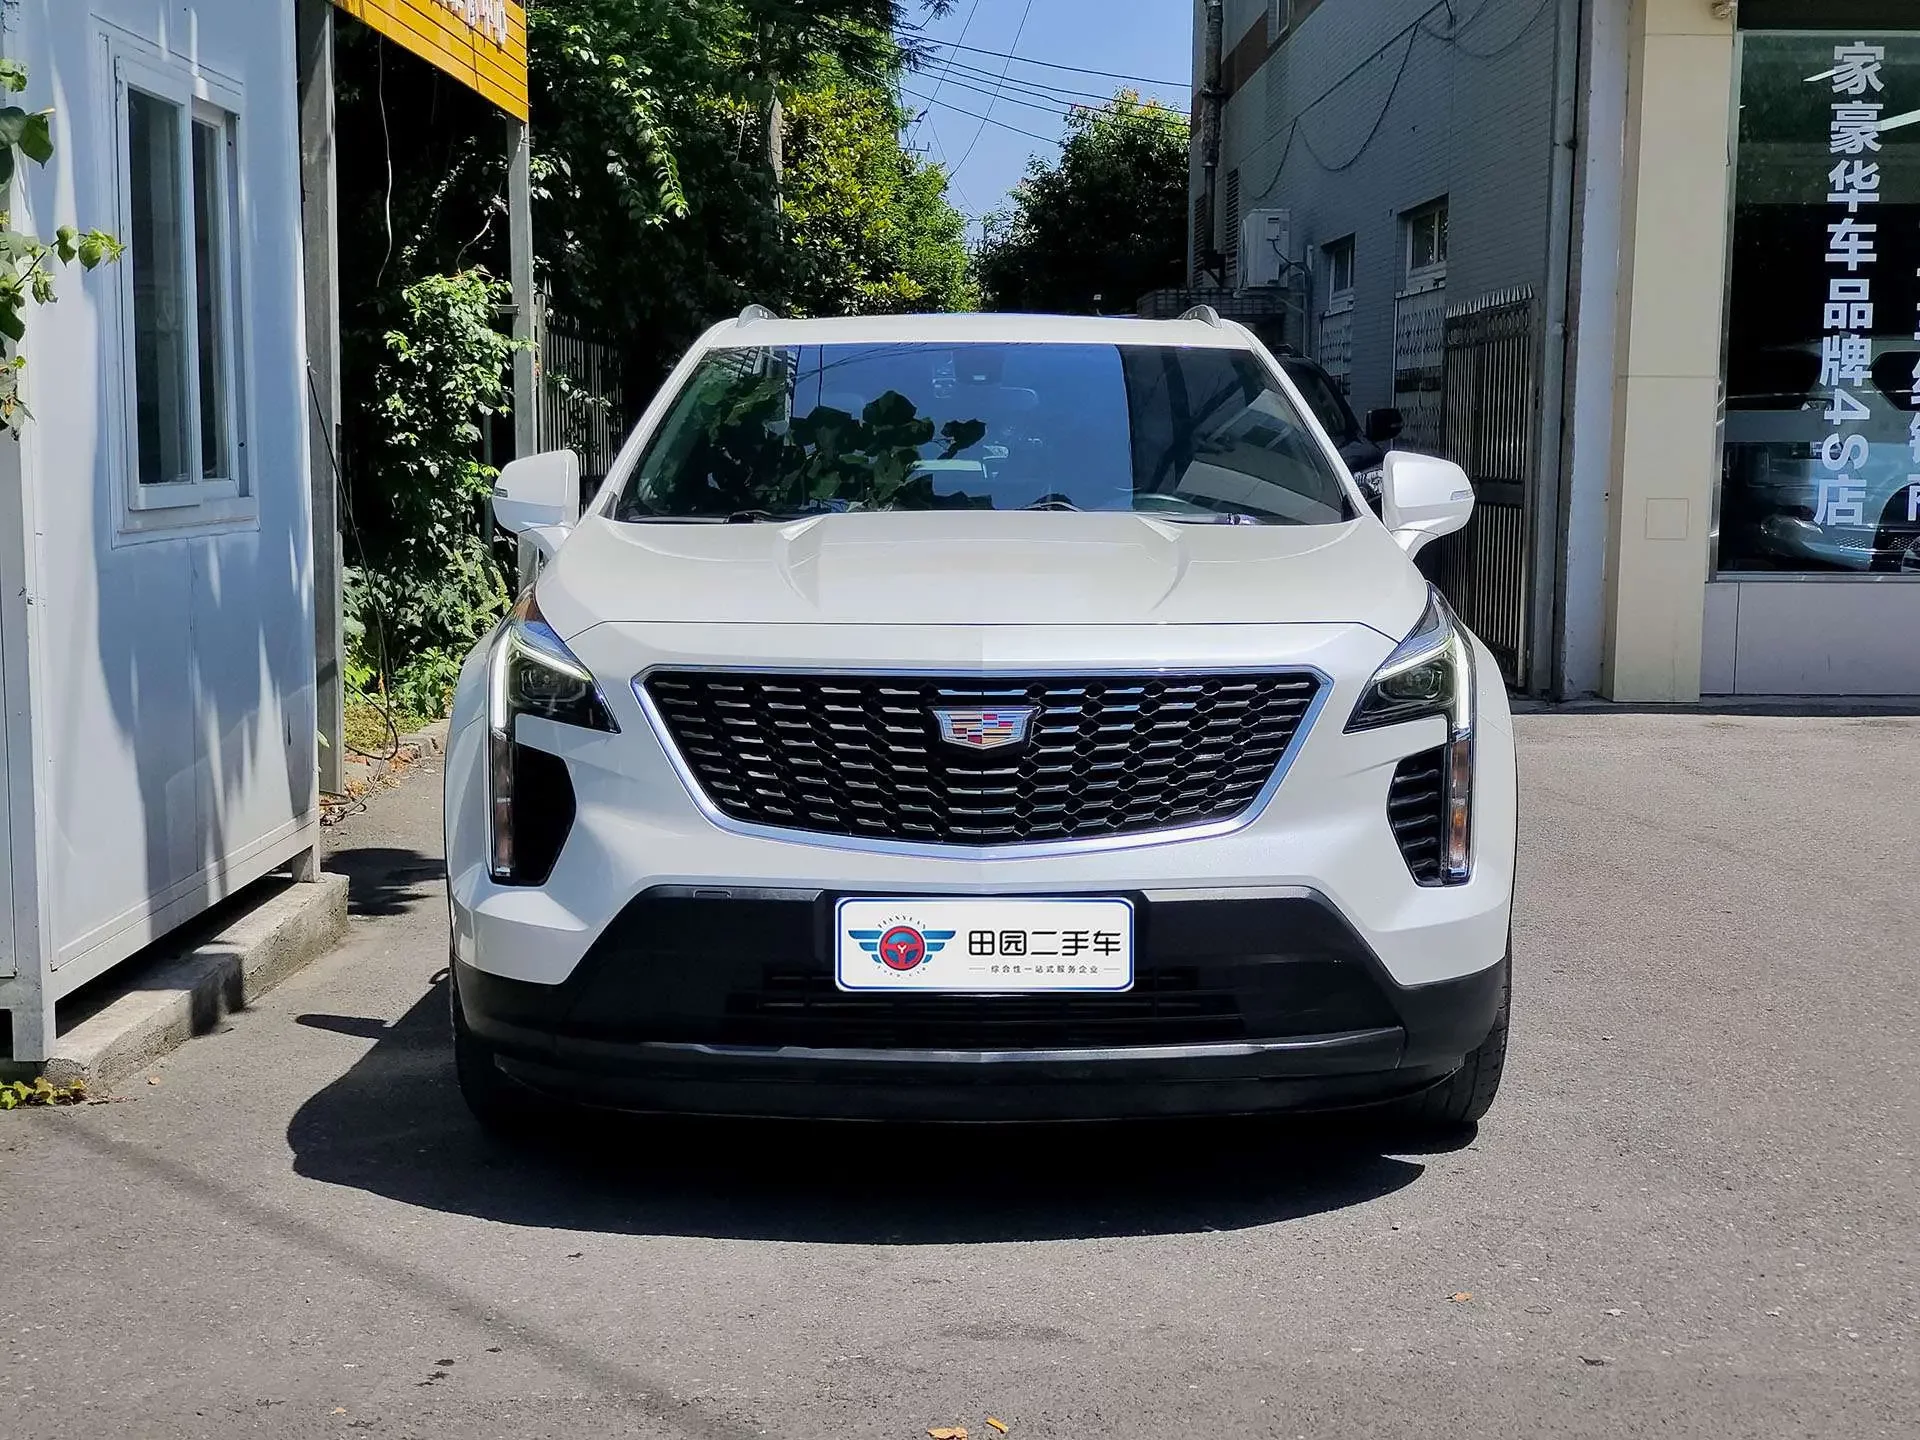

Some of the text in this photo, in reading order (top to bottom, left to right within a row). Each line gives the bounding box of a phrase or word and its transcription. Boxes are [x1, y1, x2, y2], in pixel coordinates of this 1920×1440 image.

[1814, 41, 1885, 526] 家豪华车品牌4S店
[968, 930, 1121, 957] 田园二手车
[990, 965, 1098, 974] 综合性一站式服务企业
